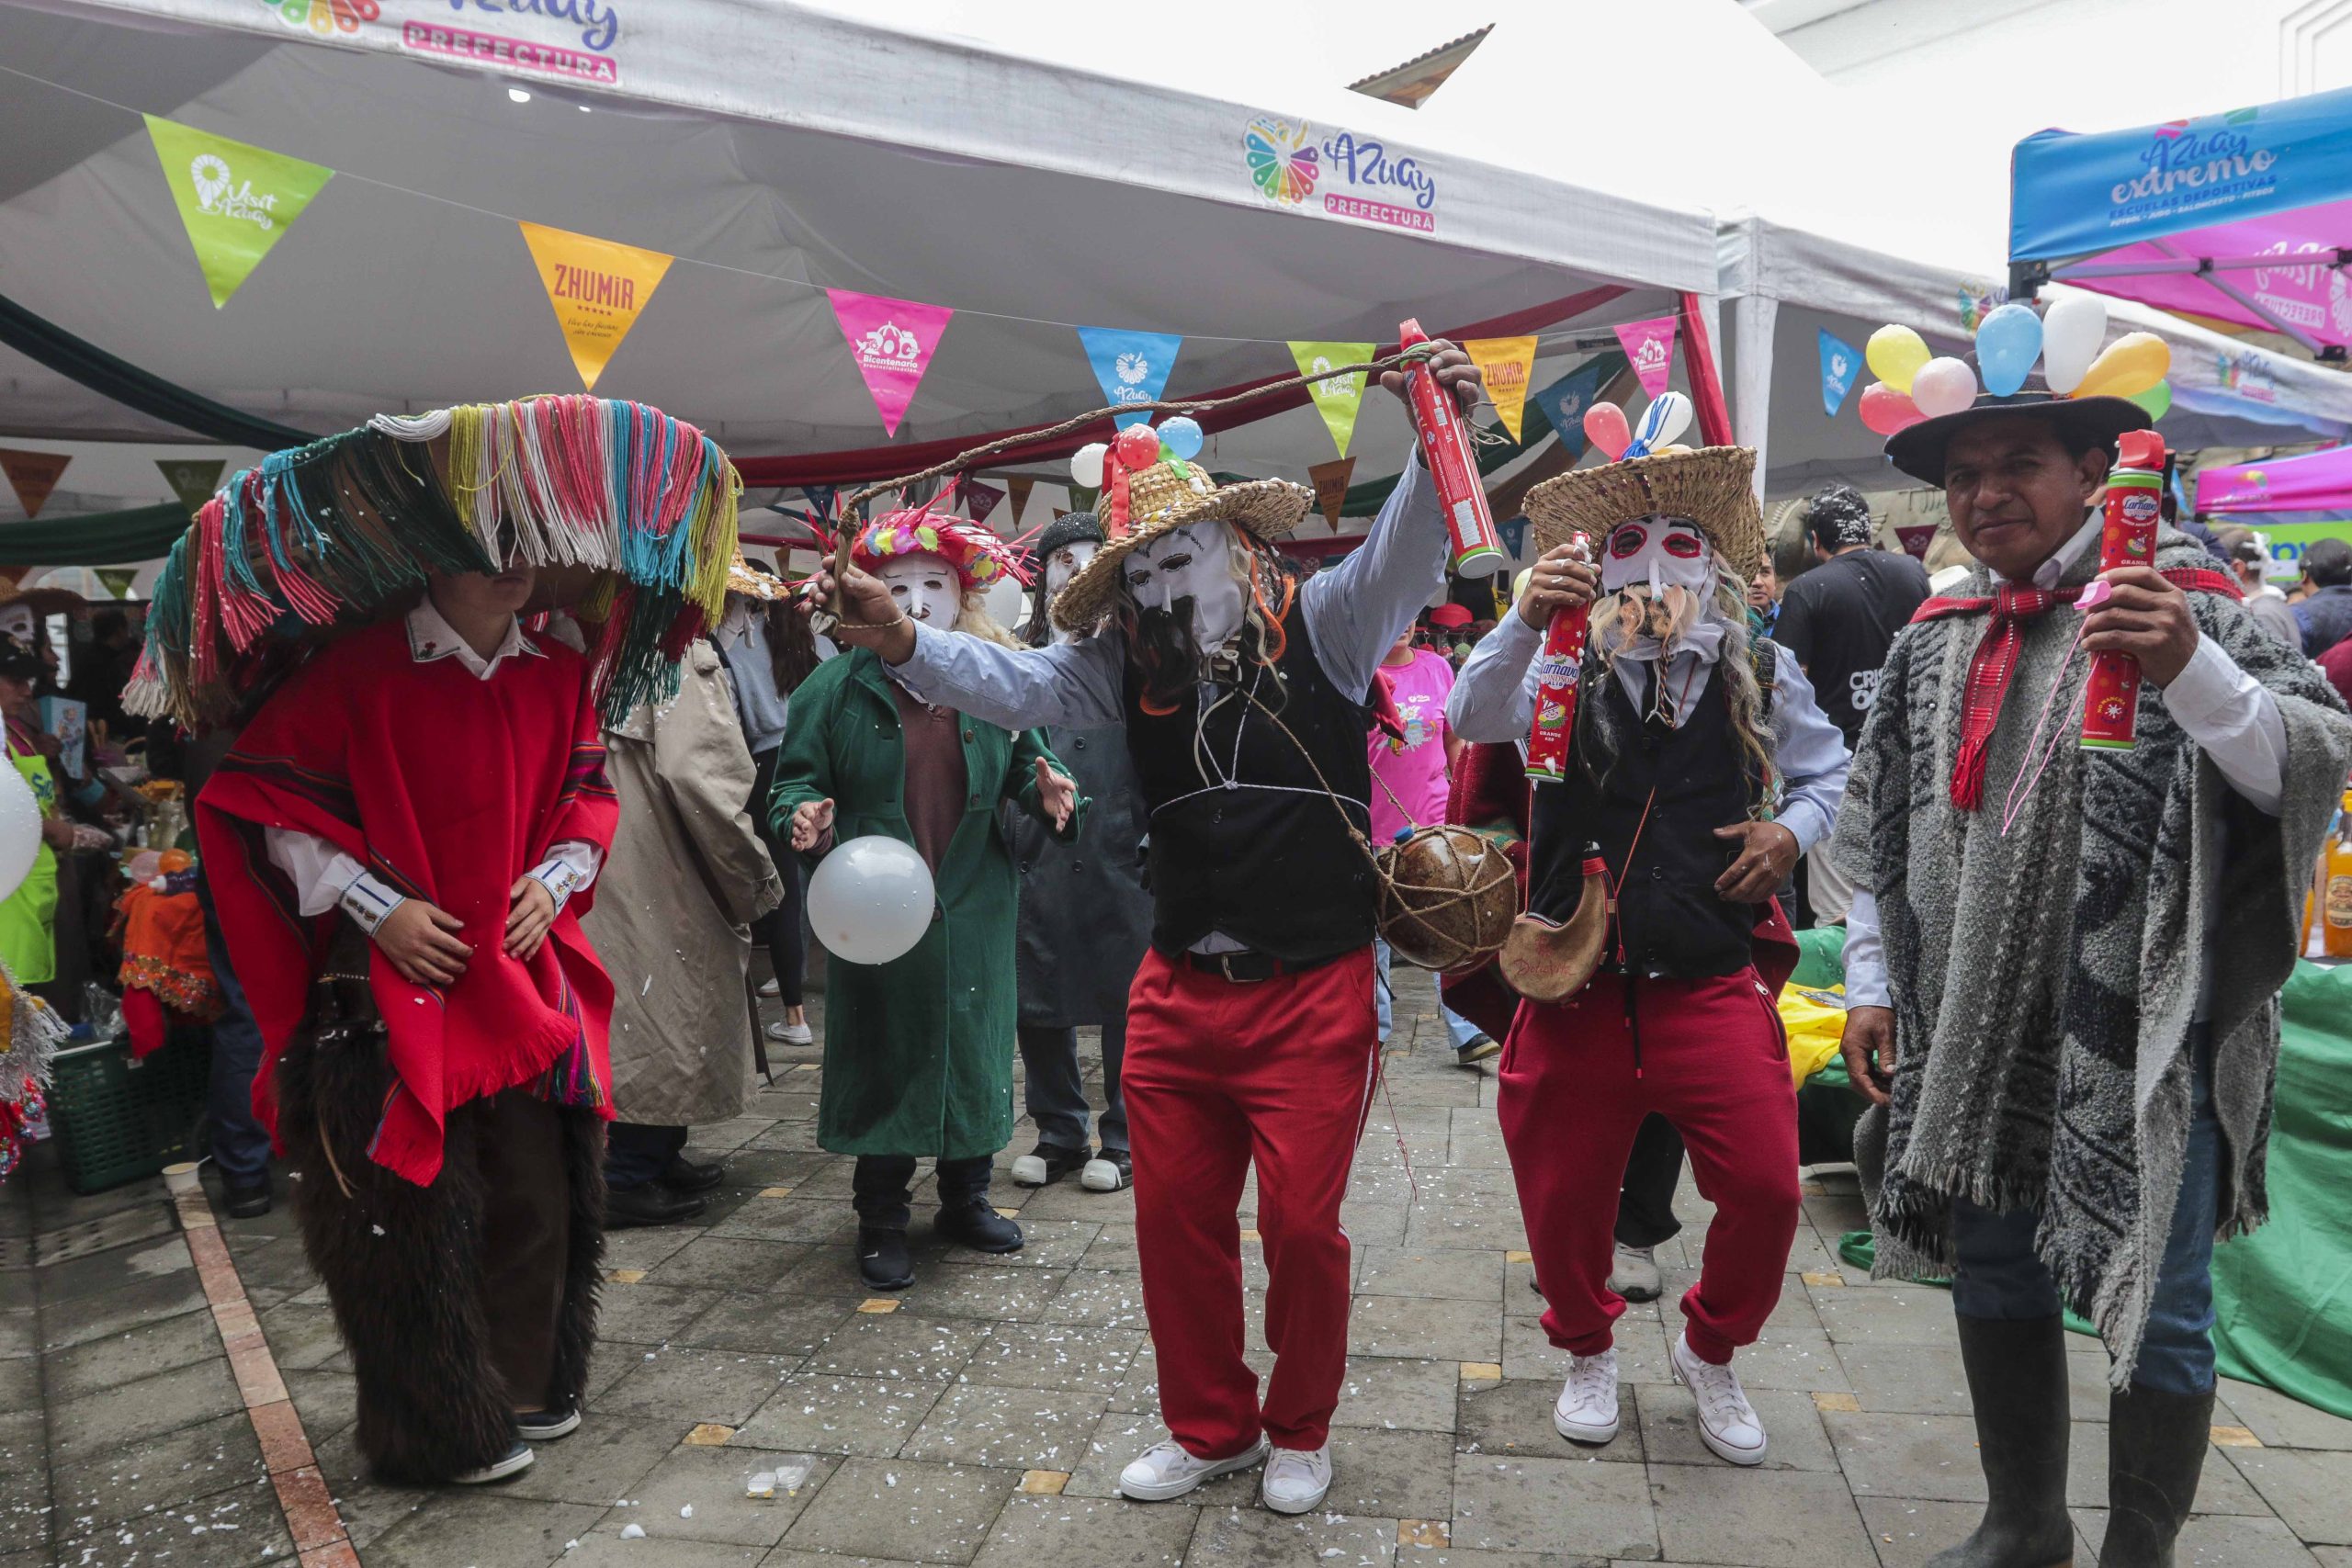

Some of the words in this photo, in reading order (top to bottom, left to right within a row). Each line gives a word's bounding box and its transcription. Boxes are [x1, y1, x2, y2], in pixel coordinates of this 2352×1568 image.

[407, 24, 615, 82] PREFECTURA
[1323, 131, 1436, 210] Azuay
[2139, 130, 2248, 173] Azuay
[227, 179, 278, 211] Visit
[2109, 196, 2179, 220] ESCUELAS
[2183, 175, 2278, 203] DEPORTIVAS
[2110, 149, 2278, 205] extremo
[1326, 196, 1434, 231] PREFECTURA
[1539, 730, 1562, 739] GRANDE
